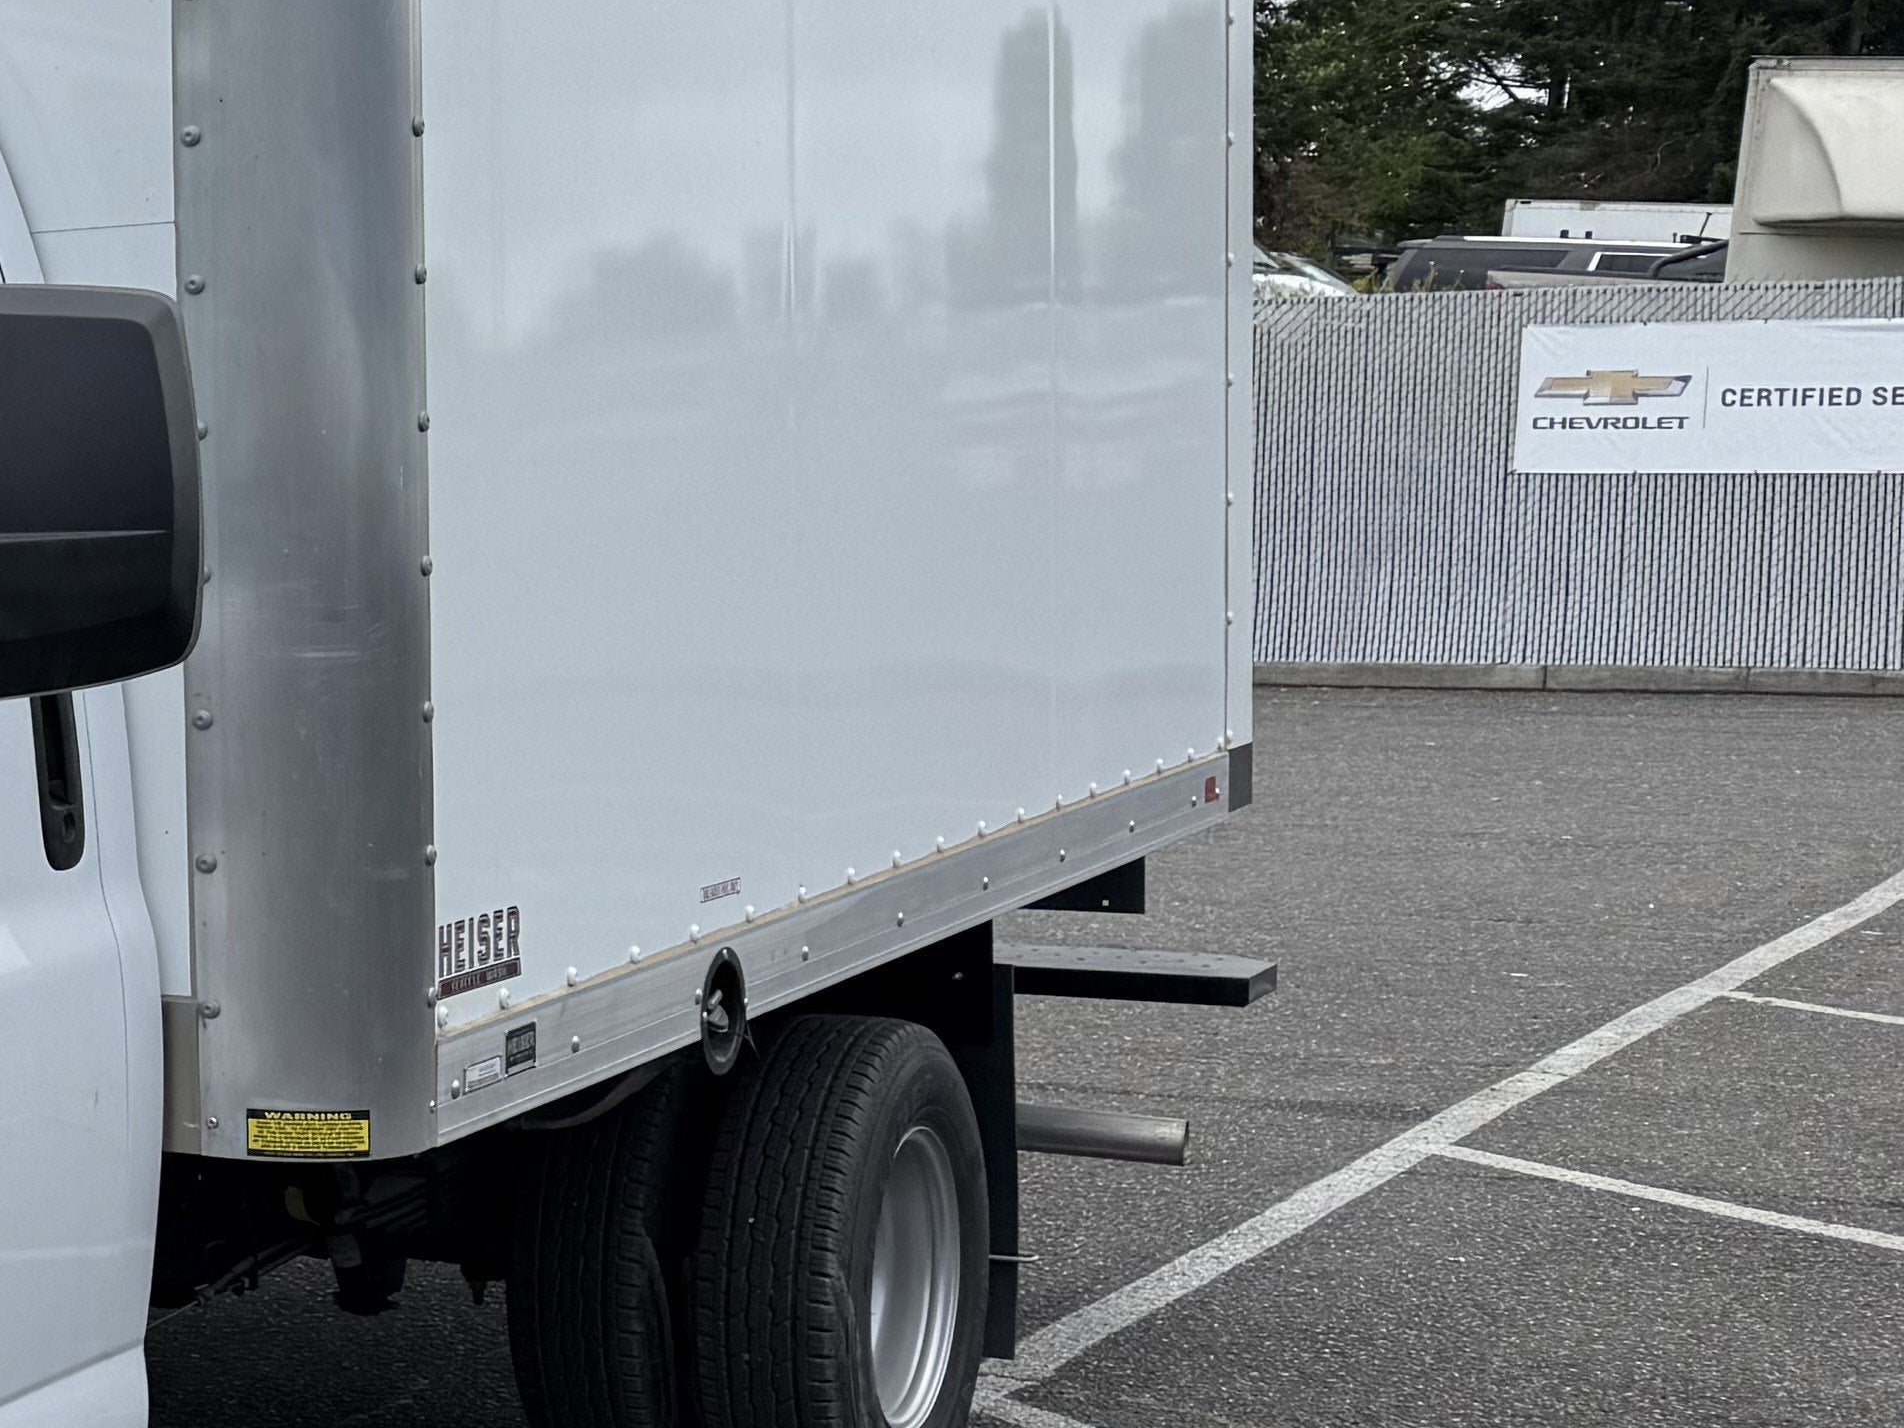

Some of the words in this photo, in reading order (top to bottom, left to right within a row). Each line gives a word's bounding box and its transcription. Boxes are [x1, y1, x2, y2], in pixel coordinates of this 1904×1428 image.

[1720, 386, 1863, 408] CERTIFIED
[1532, 416, 1690, 430] CHEVROLET
[438, 905, 521, 979] HEISER
[264, 1111, 352, 1121] WARNING
